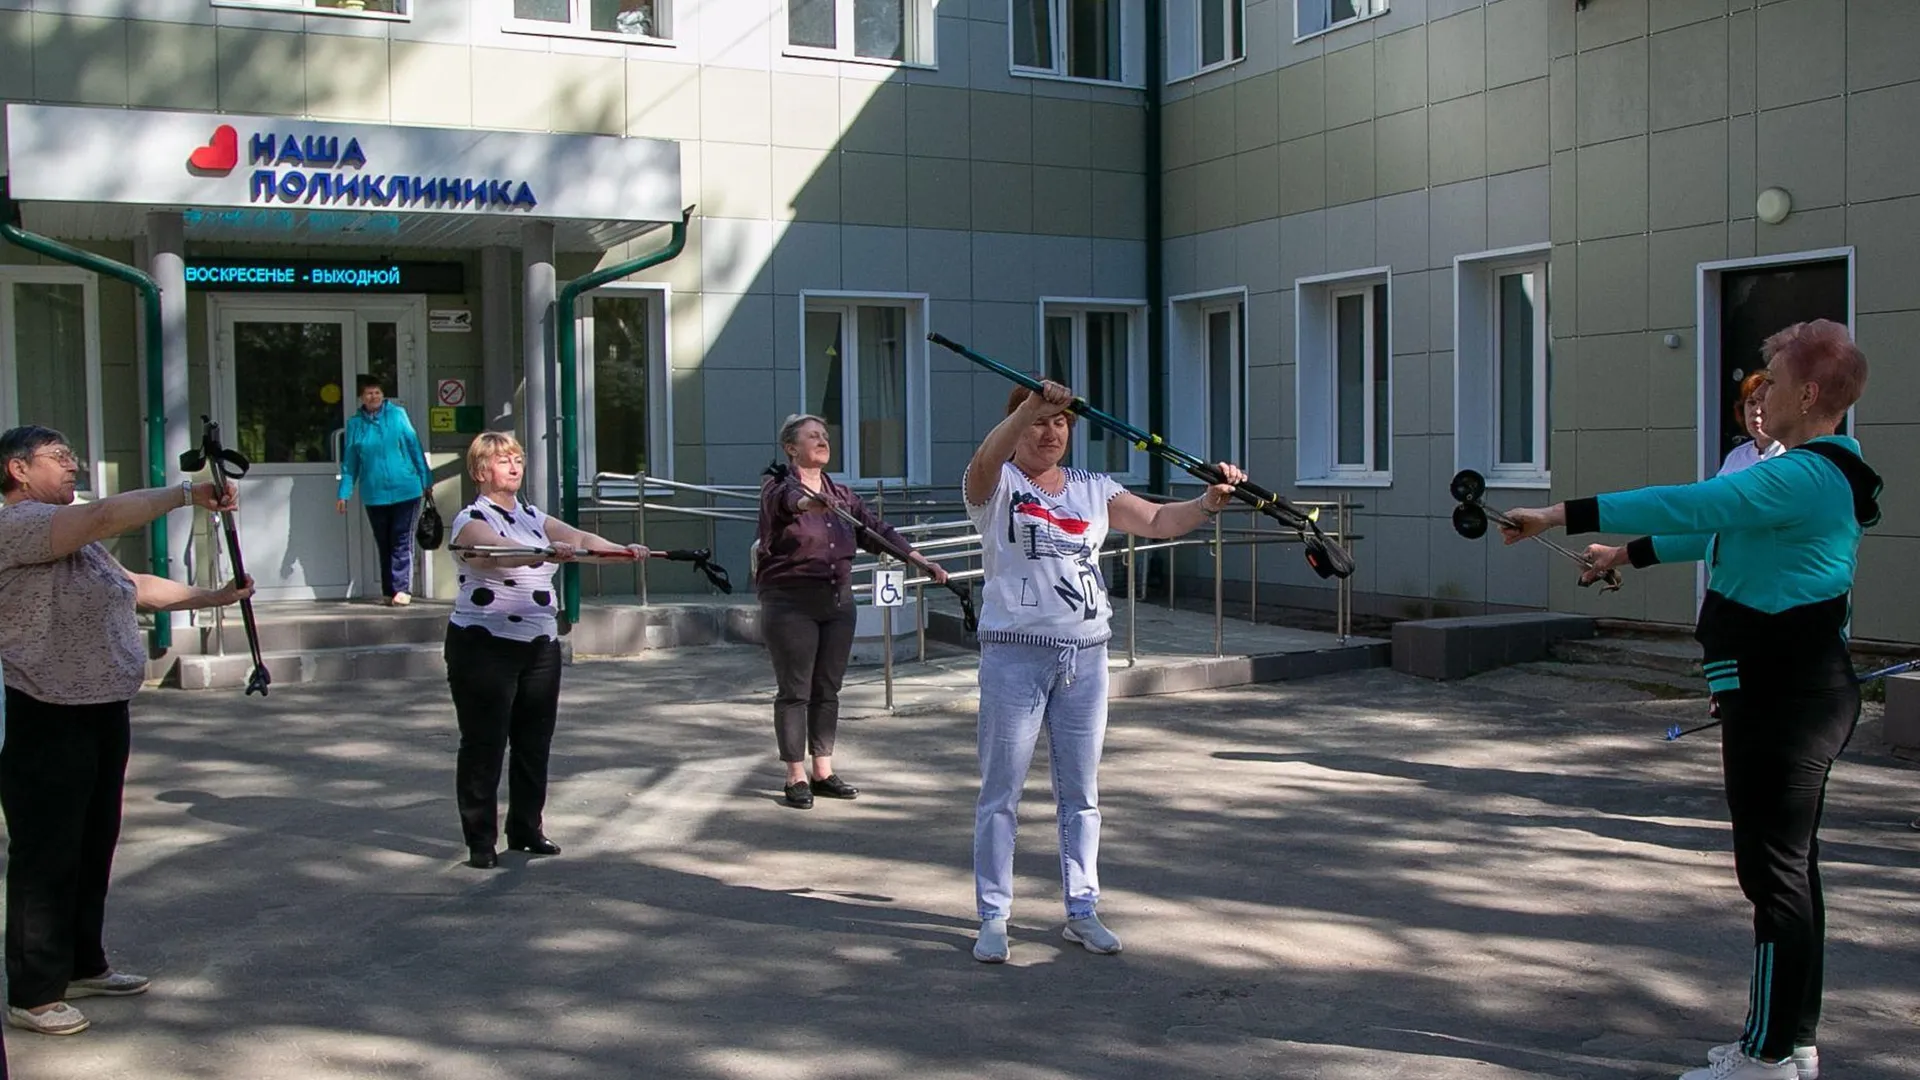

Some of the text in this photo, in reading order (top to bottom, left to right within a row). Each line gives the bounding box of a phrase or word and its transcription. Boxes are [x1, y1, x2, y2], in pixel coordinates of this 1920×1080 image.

[250, 133, 367, 167] НАША
[250, 170, 537, 212] ПОЛИКЛИНИКА
[186, 267, 295, 283] ВОСКРЕСЕНЬЕ
[312, 266, 400, 286] ВЫХОДНОЙ
